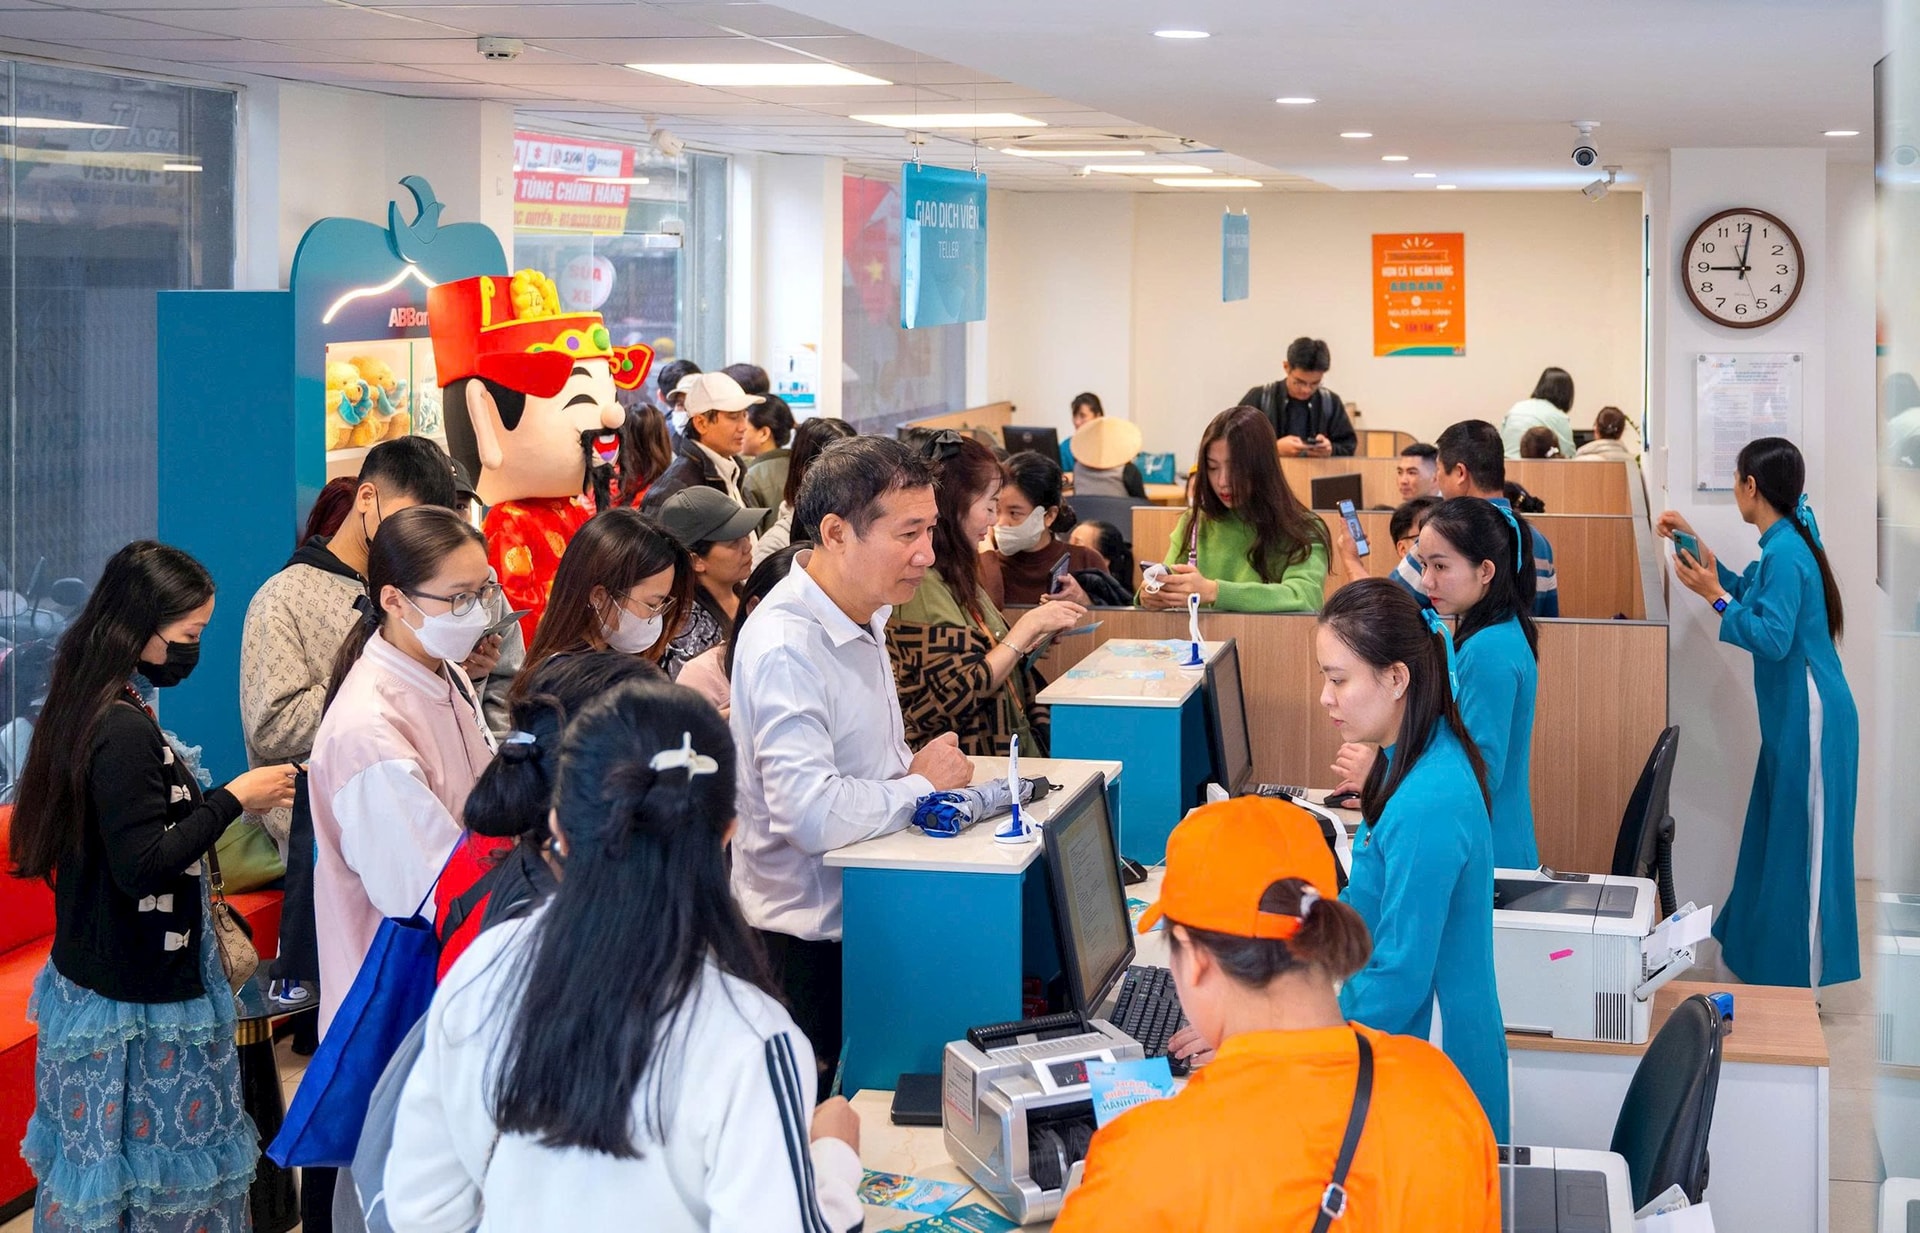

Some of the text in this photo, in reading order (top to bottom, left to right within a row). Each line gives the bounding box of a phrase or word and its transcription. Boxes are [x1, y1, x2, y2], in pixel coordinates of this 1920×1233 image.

[915, 197, 980, 235] GIAO DỊCH VIÊN
[1718, 228, 1729, 238] 11
[1737, 222, 1752, 233] 12
[1763, 228, 1768, 238] 1
[938, 241, 959, 258] TELLER
[1702, 242, 1715, 253] 10
[1771, 245, 1784, 256] 2
[1698, 262, 1710, 273] 9
[1776, 264, 1788, 275] 3
[1701, 282, 1713, 293] 8
[1770, 284, 1782, 294] 4
[1716, 297, 1726, 308] 7
[1756, 299, 1768, 309] 5
[1735, 304, 1747, 315] 6
[388, 307, 428, 327] ABBan
